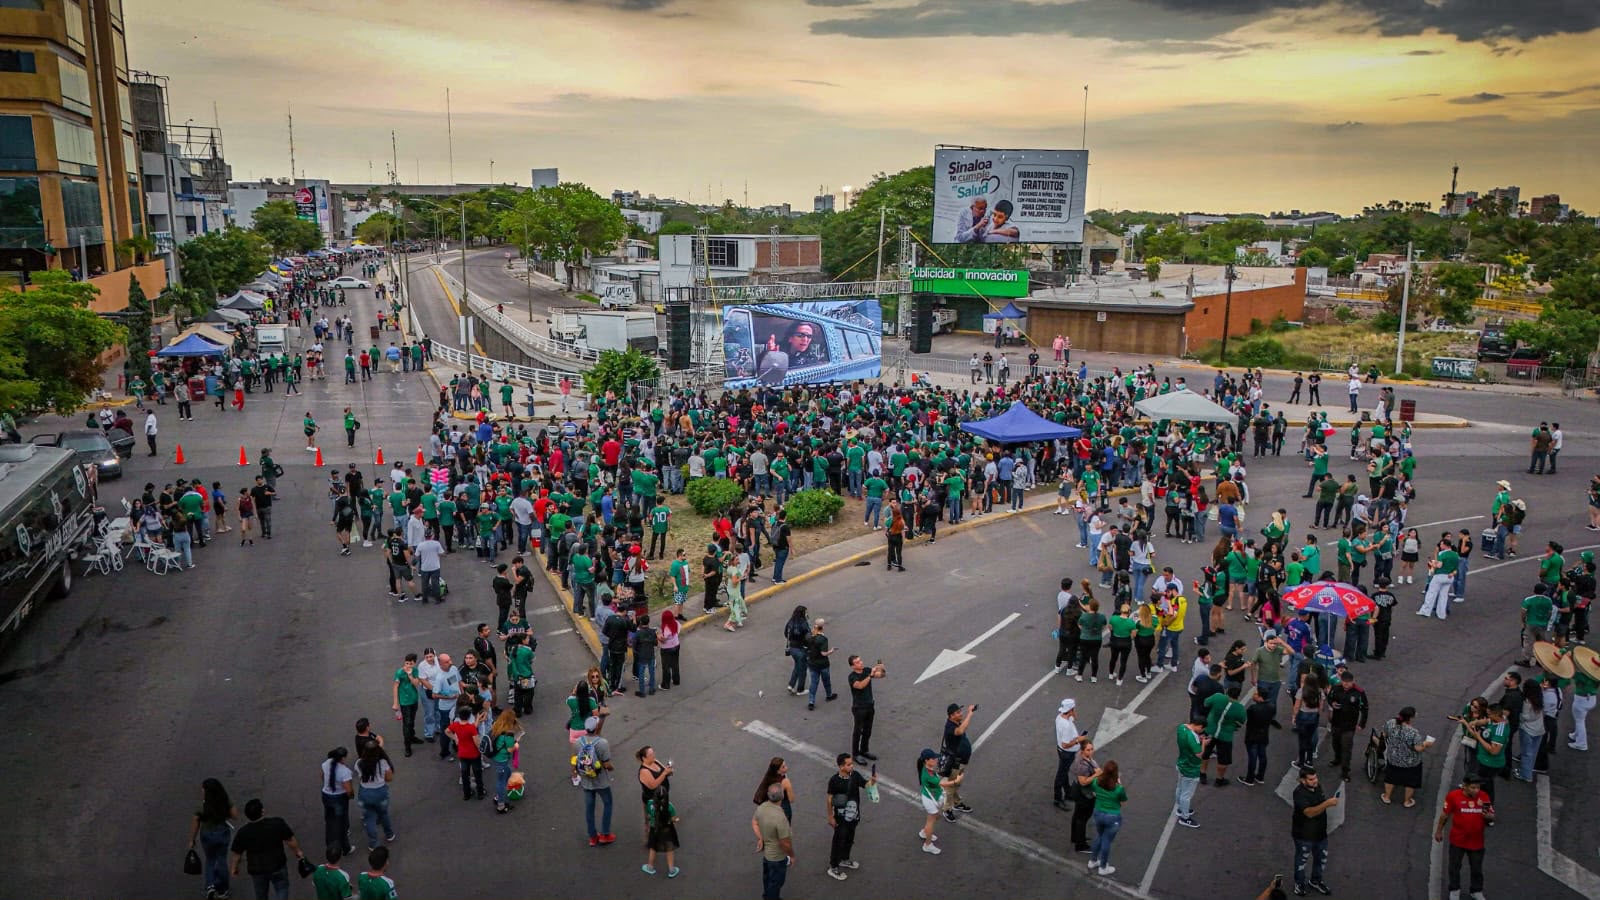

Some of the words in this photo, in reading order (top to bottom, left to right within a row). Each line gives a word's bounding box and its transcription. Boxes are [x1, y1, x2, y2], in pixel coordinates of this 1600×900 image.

[949, 159, 992, 174] Sinaloa
[957, 182, 988, 198] Salud
[1022, 180, 1064, 191] GRATUITOS
[908, 267, 955, 280] Publicidad
[966, 269, 1018, 281] innovación
[656, 511, 667, 523] 10
